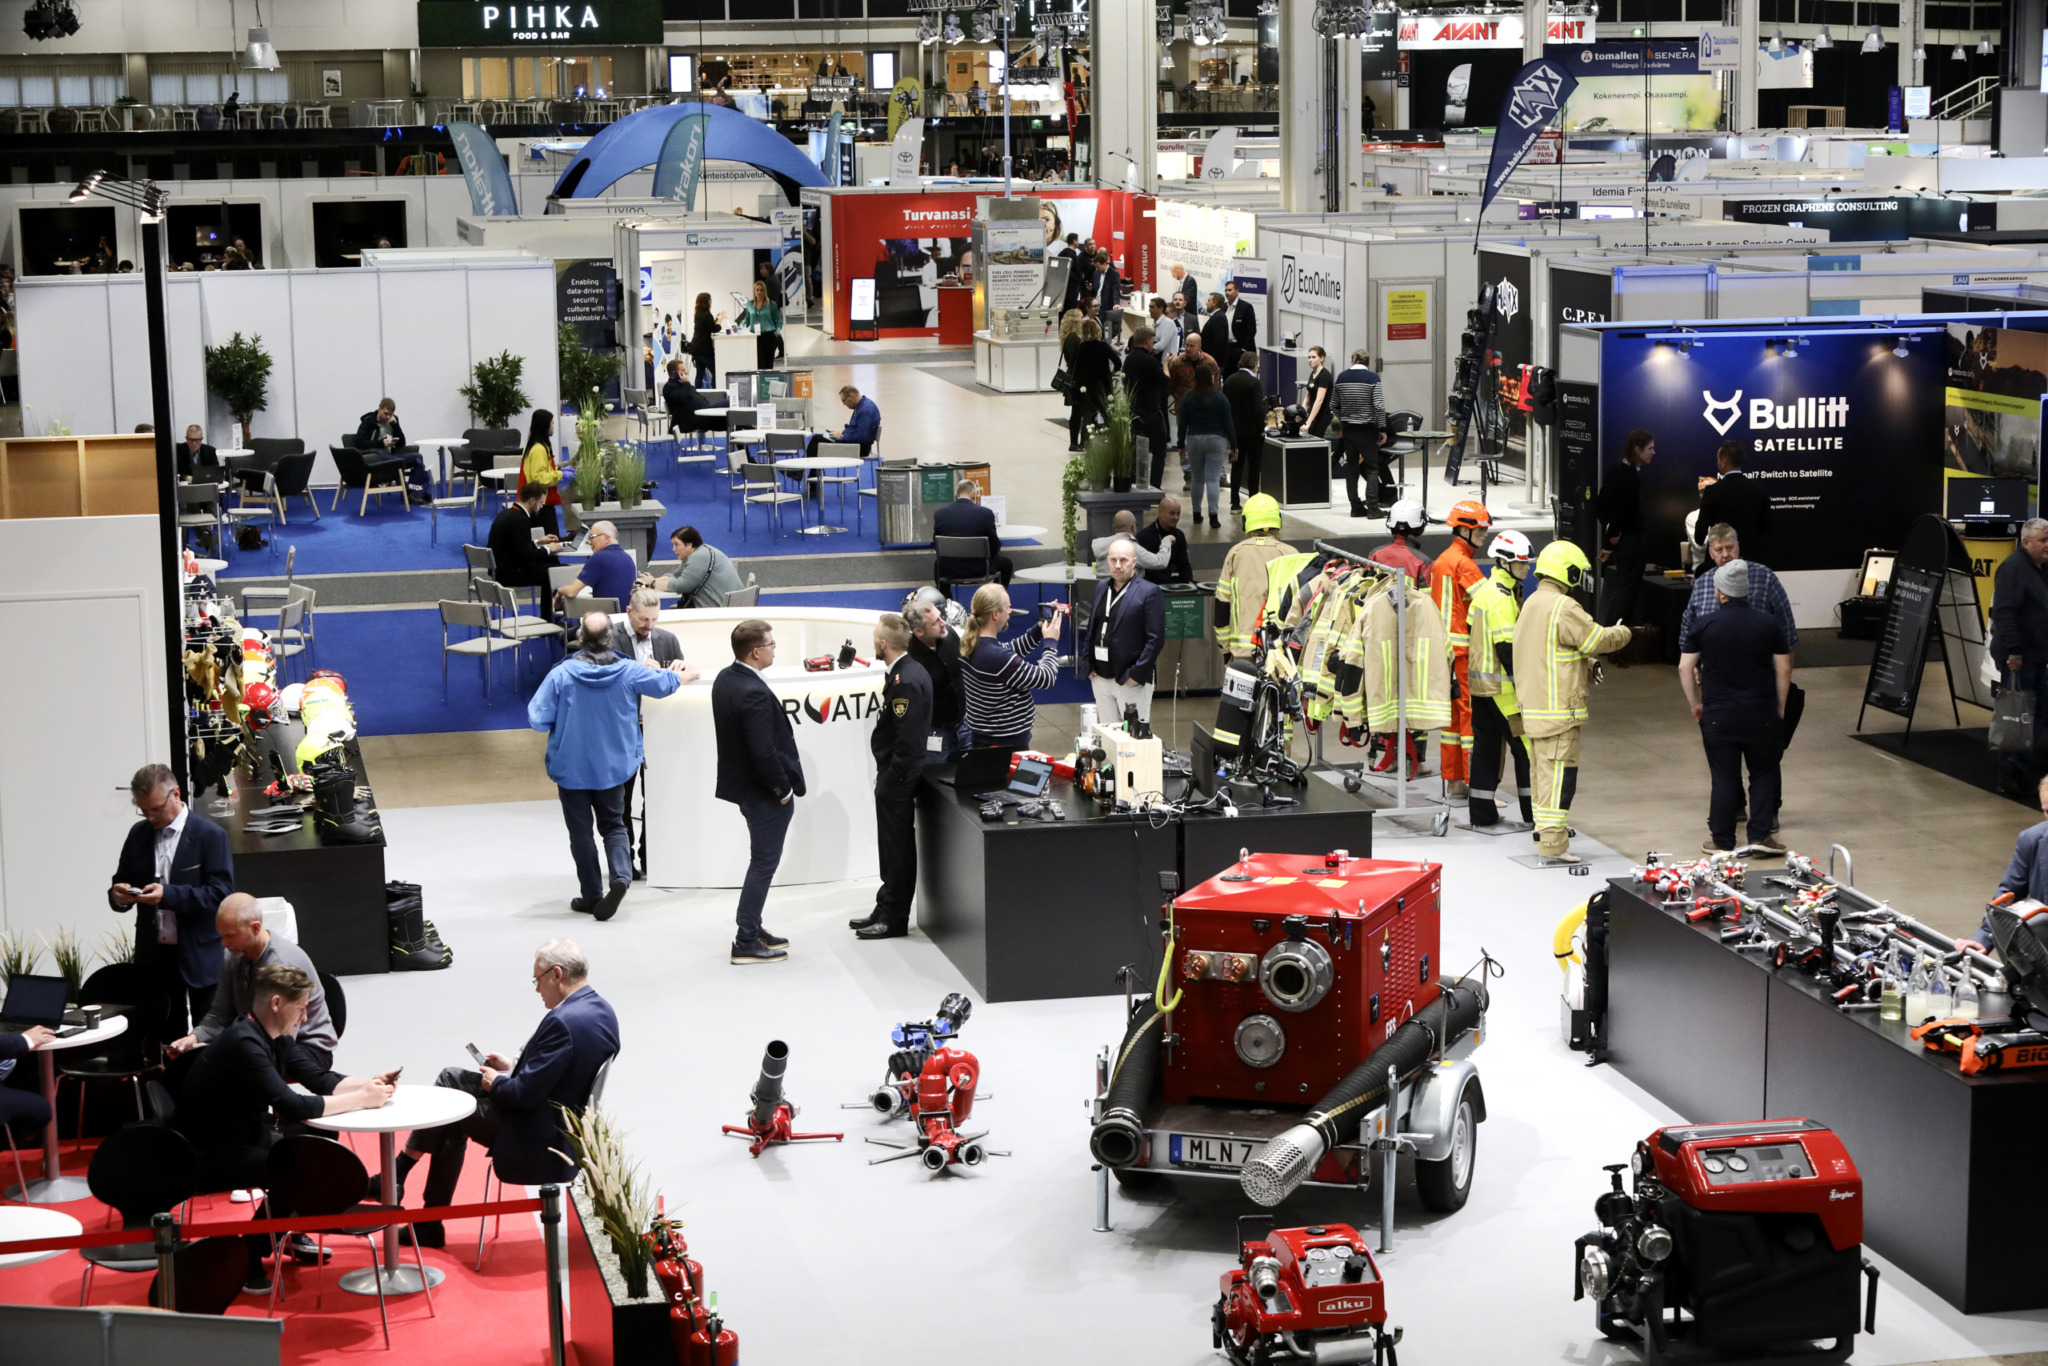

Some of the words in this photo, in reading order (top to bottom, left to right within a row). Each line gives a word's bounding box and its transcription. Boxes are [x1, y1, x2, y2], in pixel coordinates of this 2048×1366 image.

[483, 5, 599, 29] PIHKA
[550, 31, 570, 39] BAR
[1398, 23, 1419, 41] AVANT
[1432, 22, 1499, 40] AVANT
[1594, 51, 1639, 60] tomallen
[1654, 51, 1696, 60] SENERA
[1593, 92, 1643, 100] Kokeneempi.
[1493, 132, 1537, 188] www.haix.com
[1592, 187, 1625, 196] Idemia
[1742, 204, 1781, 213] FROZEN
[1782, 202, 1835, 212] GRAPHENE
[1836, 201, 1898, 212] CONSULTING
[903, 207, 971, 221] Turvanasi
[571, 278, 599, 286] Enabling
[1242, 281, 1258, 289] Platform
[1298, 268, 1341, 300] EcoOnline
[1954, 275, 1968, 283] LAU
[1749, 396, 1850, 430] Bullitt
[1754, 437, 1844, 452] SATELLITE
[1760, 470, 1788, 479] Switch
[1799, 469, 1833, 478] Satellite
[1190, 1139, 1232, 1163] MLN
[1829, 1189, 1855, 1201] Ziegler
[1326, 1300, 1365, 1311] alku
